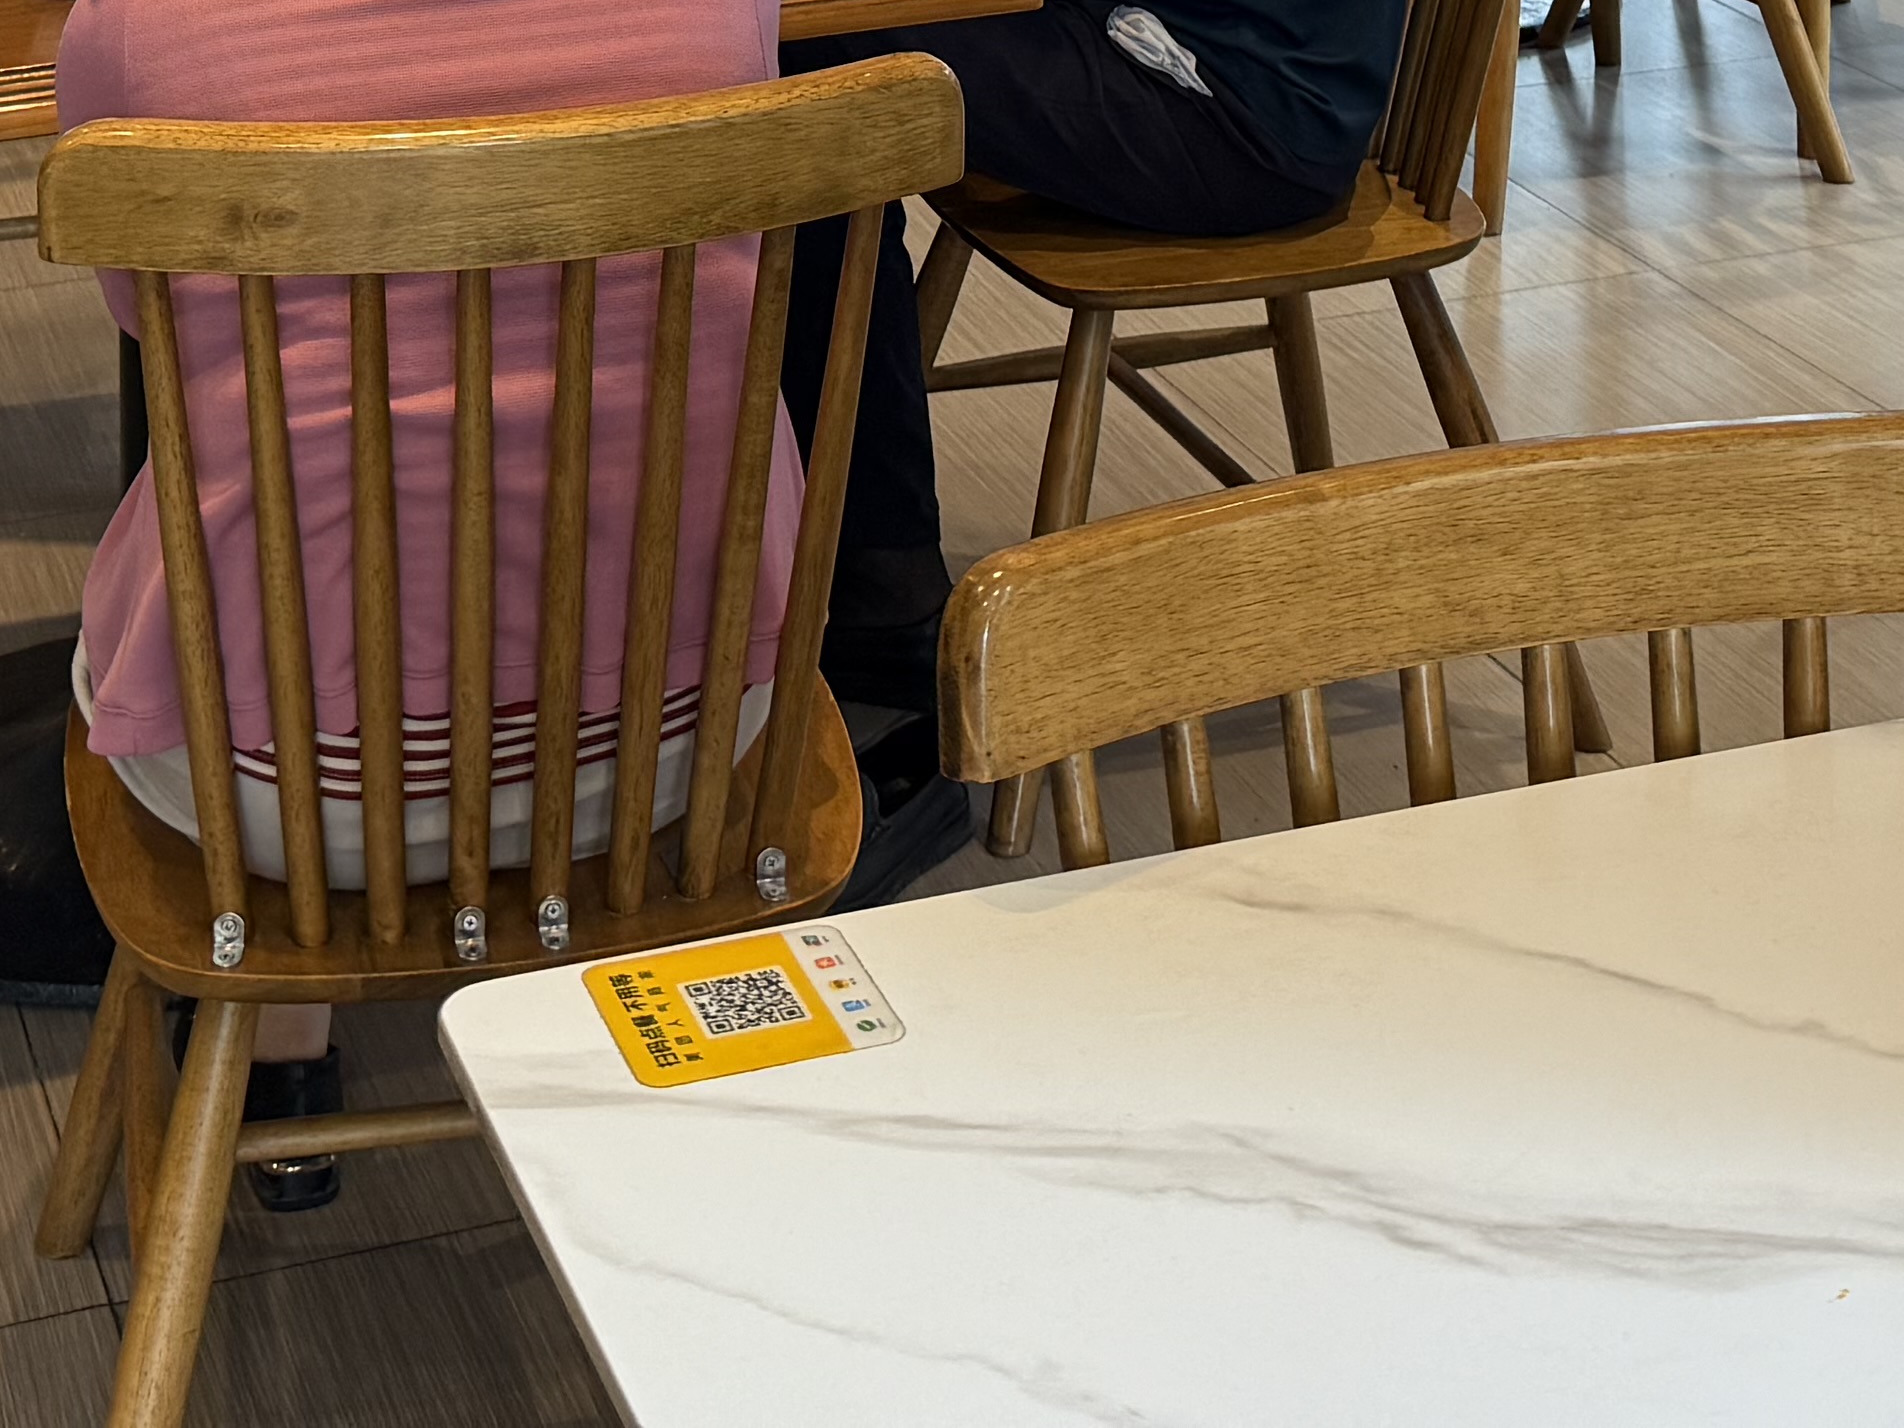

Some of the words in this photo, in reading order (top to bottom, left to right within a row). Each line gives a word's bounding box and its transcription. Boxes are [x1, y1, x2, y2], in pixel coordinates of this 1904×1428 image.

[607, 973, 648, 1013] 不用等
[631, 1014, 681, 1069] 扫码点餐
